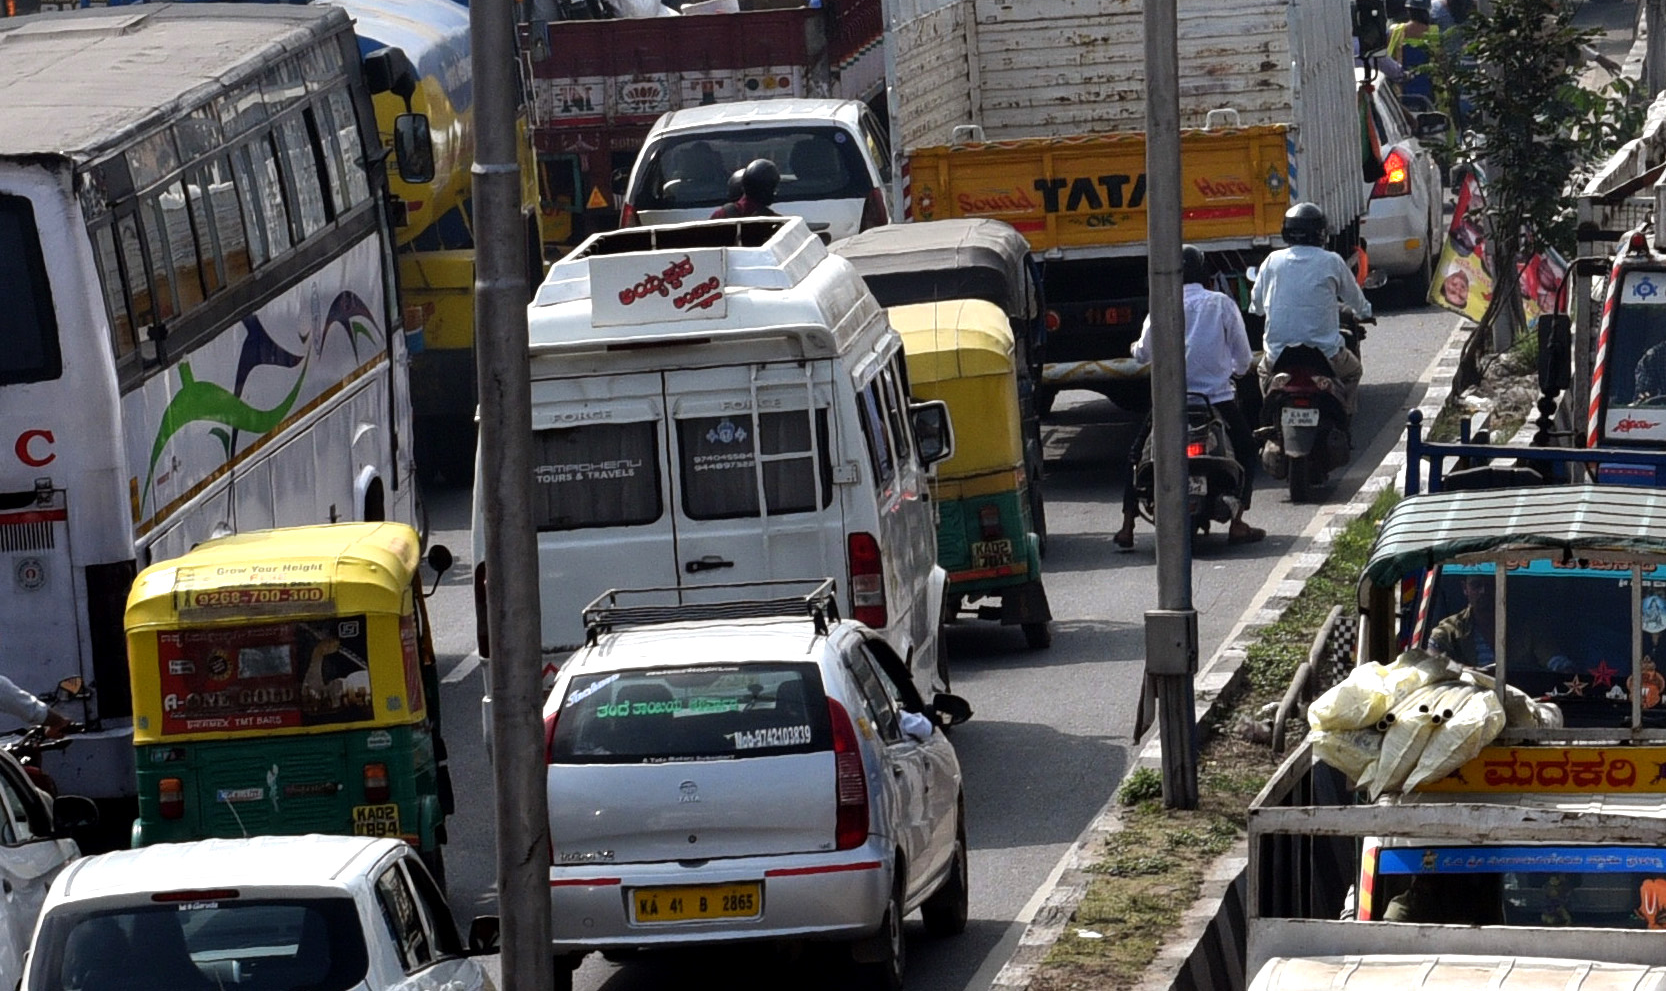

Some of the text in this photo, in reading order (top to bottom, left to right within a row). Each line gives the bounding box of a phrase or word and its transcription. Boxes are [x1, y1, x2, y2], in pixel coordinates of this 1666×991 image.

[1086, 213, 1117, 228] OK
[536, 468, 635, 484] TOURS & TRAVELS
[217, 563, 323, 576] Grow Your Height
[198, 589, 321, 606] 9268-700-300
[239, 688, 294, 707] GOLD
[234, 719, 256, 728] TMT
[1483, 750, 1637, 787] ಮದಕರಿ
[357, 806, 395, 821] KA02
[640, 894, 753, 915] KA 41 B 2865
